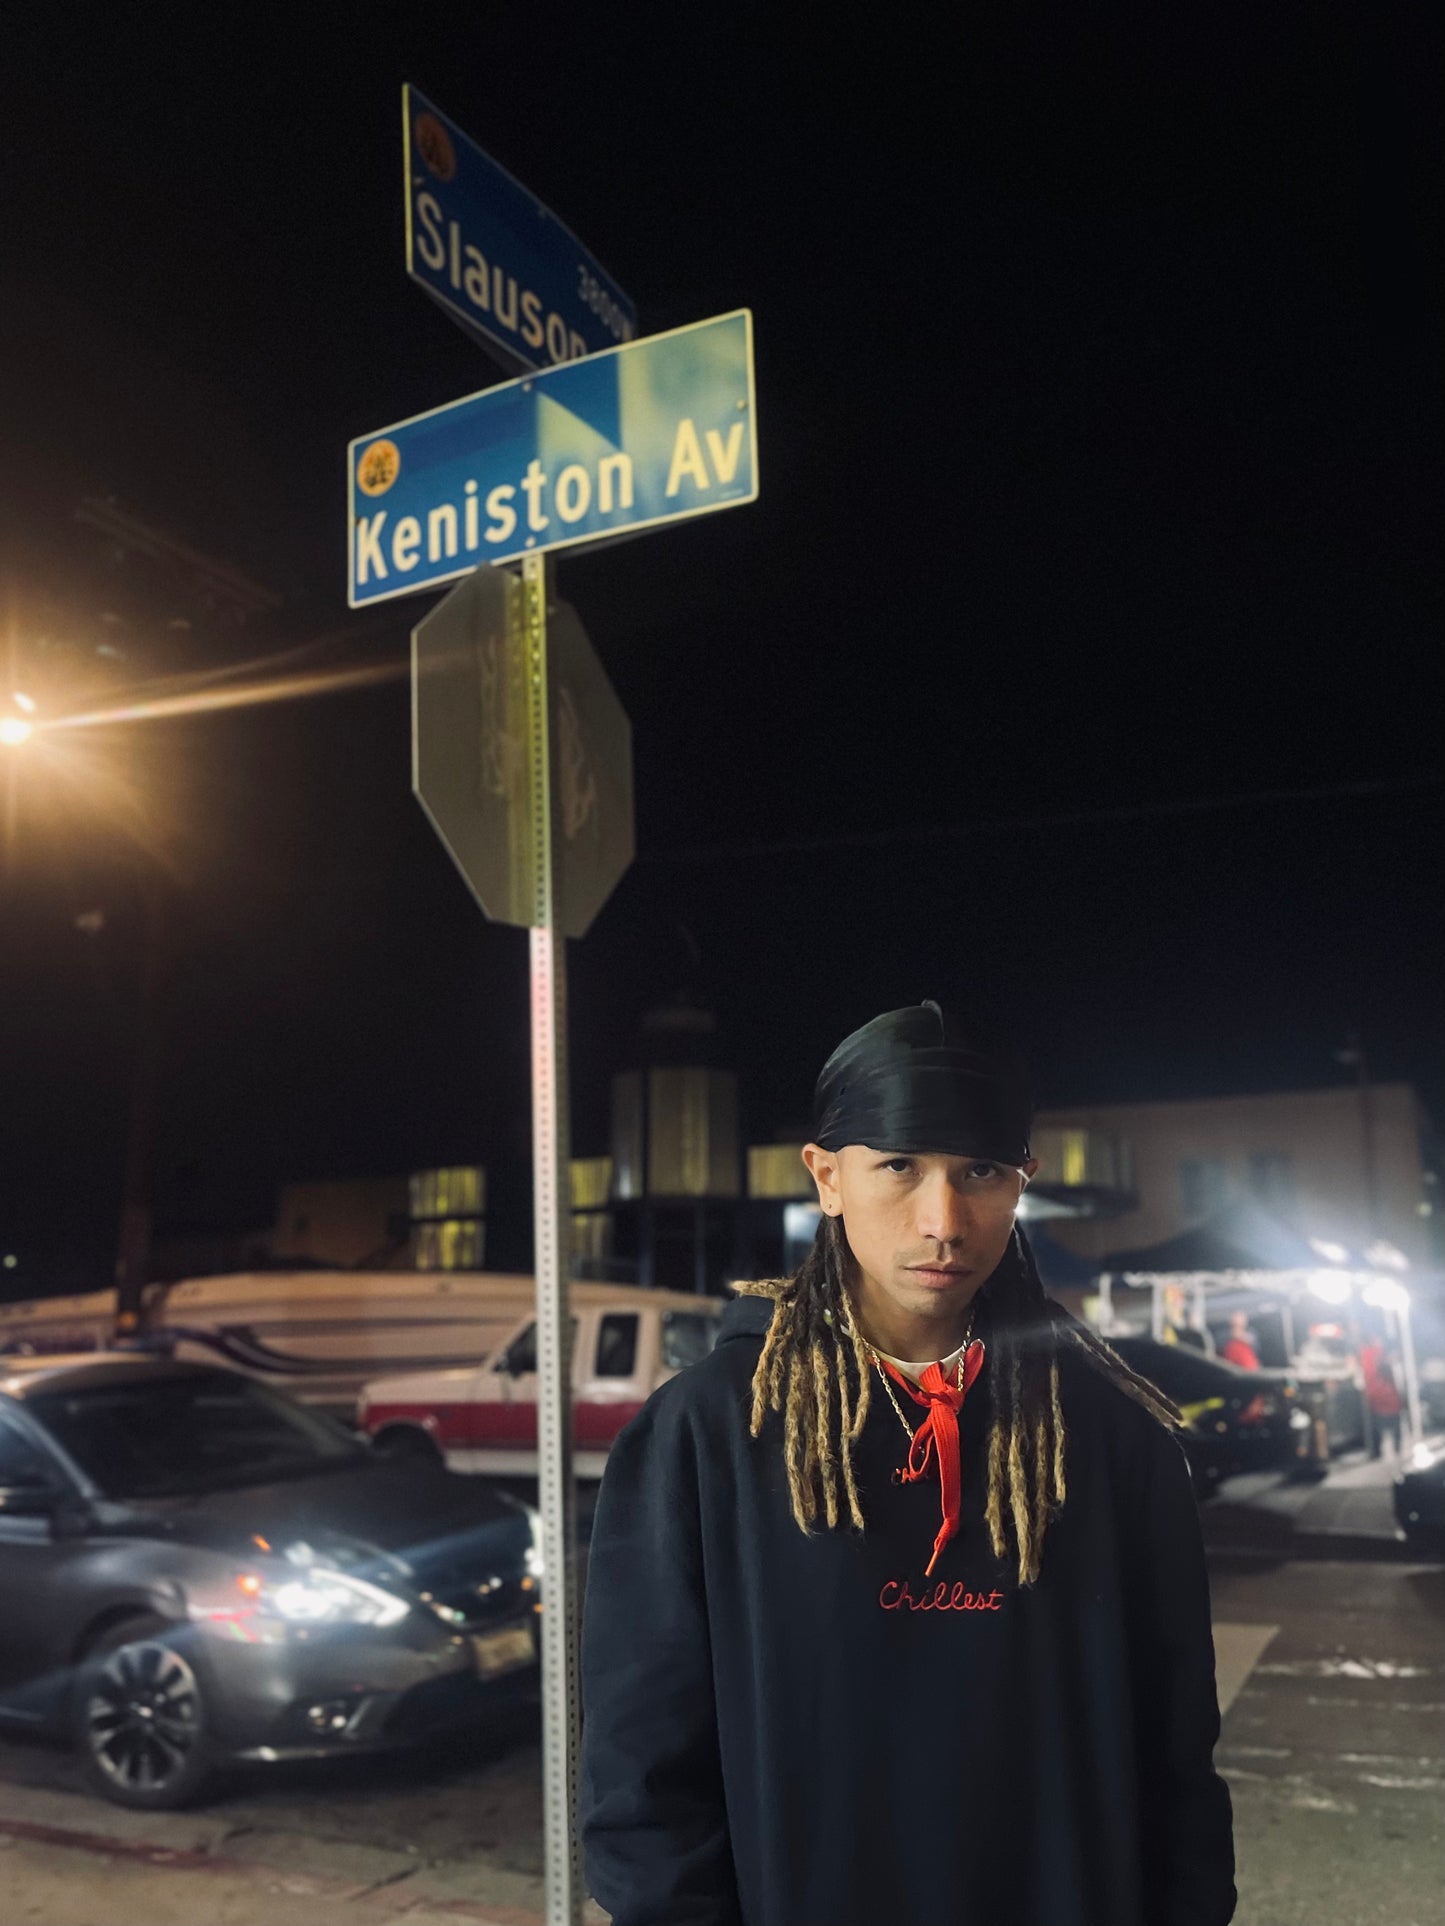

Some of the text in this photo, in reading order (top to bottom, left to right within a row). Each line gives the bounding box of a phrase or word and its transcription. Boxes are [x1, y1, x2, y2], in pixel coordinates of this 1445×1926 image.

[416, 193, 587, 364] Slauson
[356, 418, 743, 585] Keniston Av
[879, 1581, 1004, 1611] Chillest
